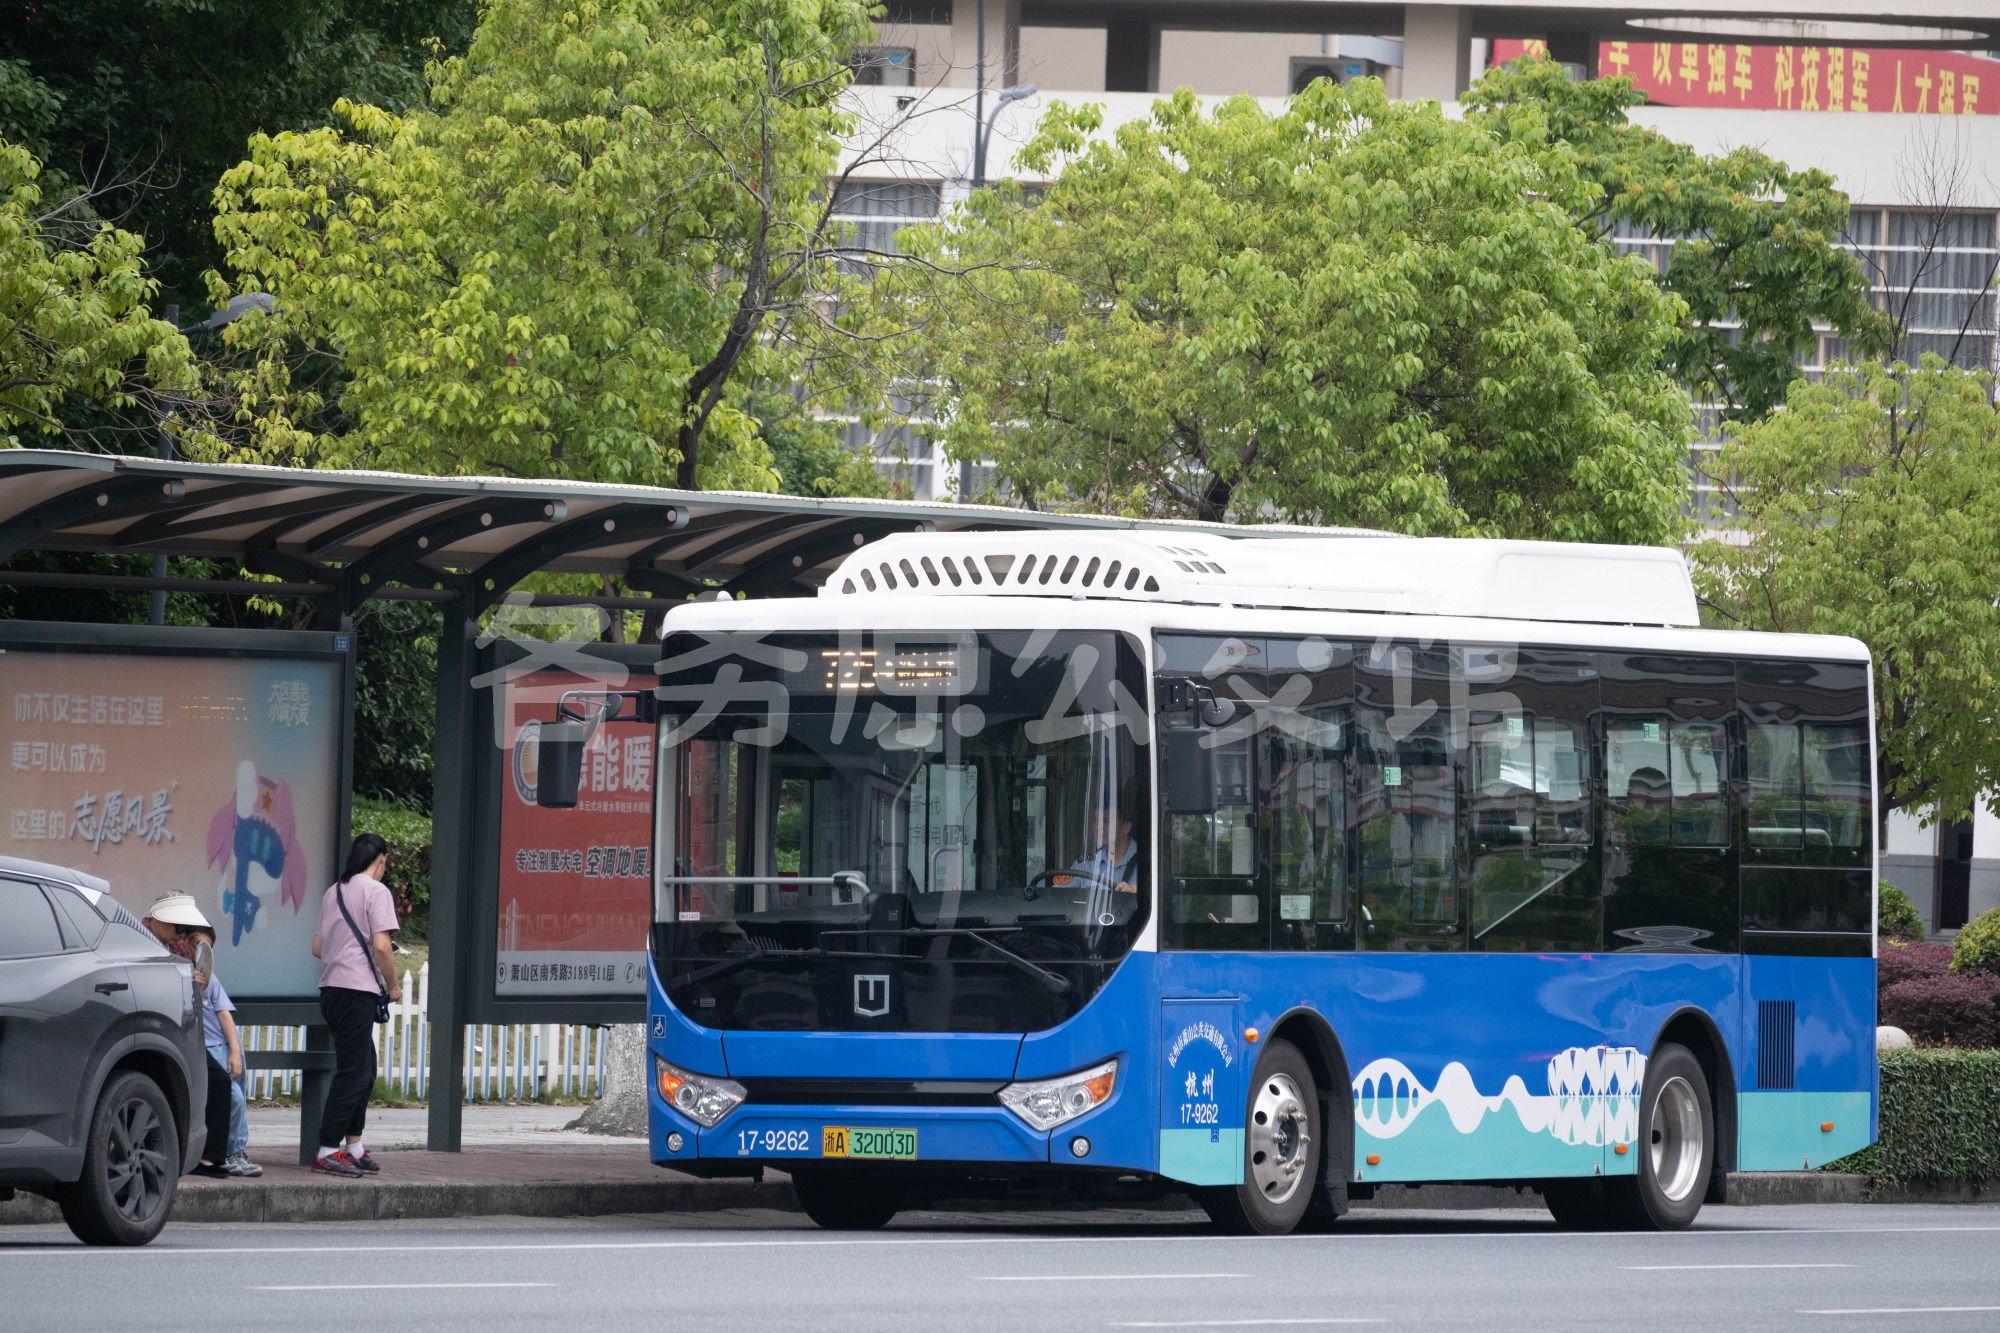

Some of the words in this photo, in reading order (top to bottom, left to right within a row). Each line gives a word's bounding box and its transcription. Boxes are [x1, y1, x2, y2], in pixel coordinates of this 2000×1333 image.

[11, 741, 106, 773] 更可以成为
[515, 849, 583, 874] 专注别墅大宅
[583, 847, 651, 879] 空调地暖
[511, 964, 615, 982] 萧山区南秀路3188号11层
[1185, 1069, 1214, 1101] 杭州
[1180, 1103, 1219, 1124] 17-9262
[738, 1130, 809, 1151] 17-9262
[853, 1132, 915, 1155] 32003D
